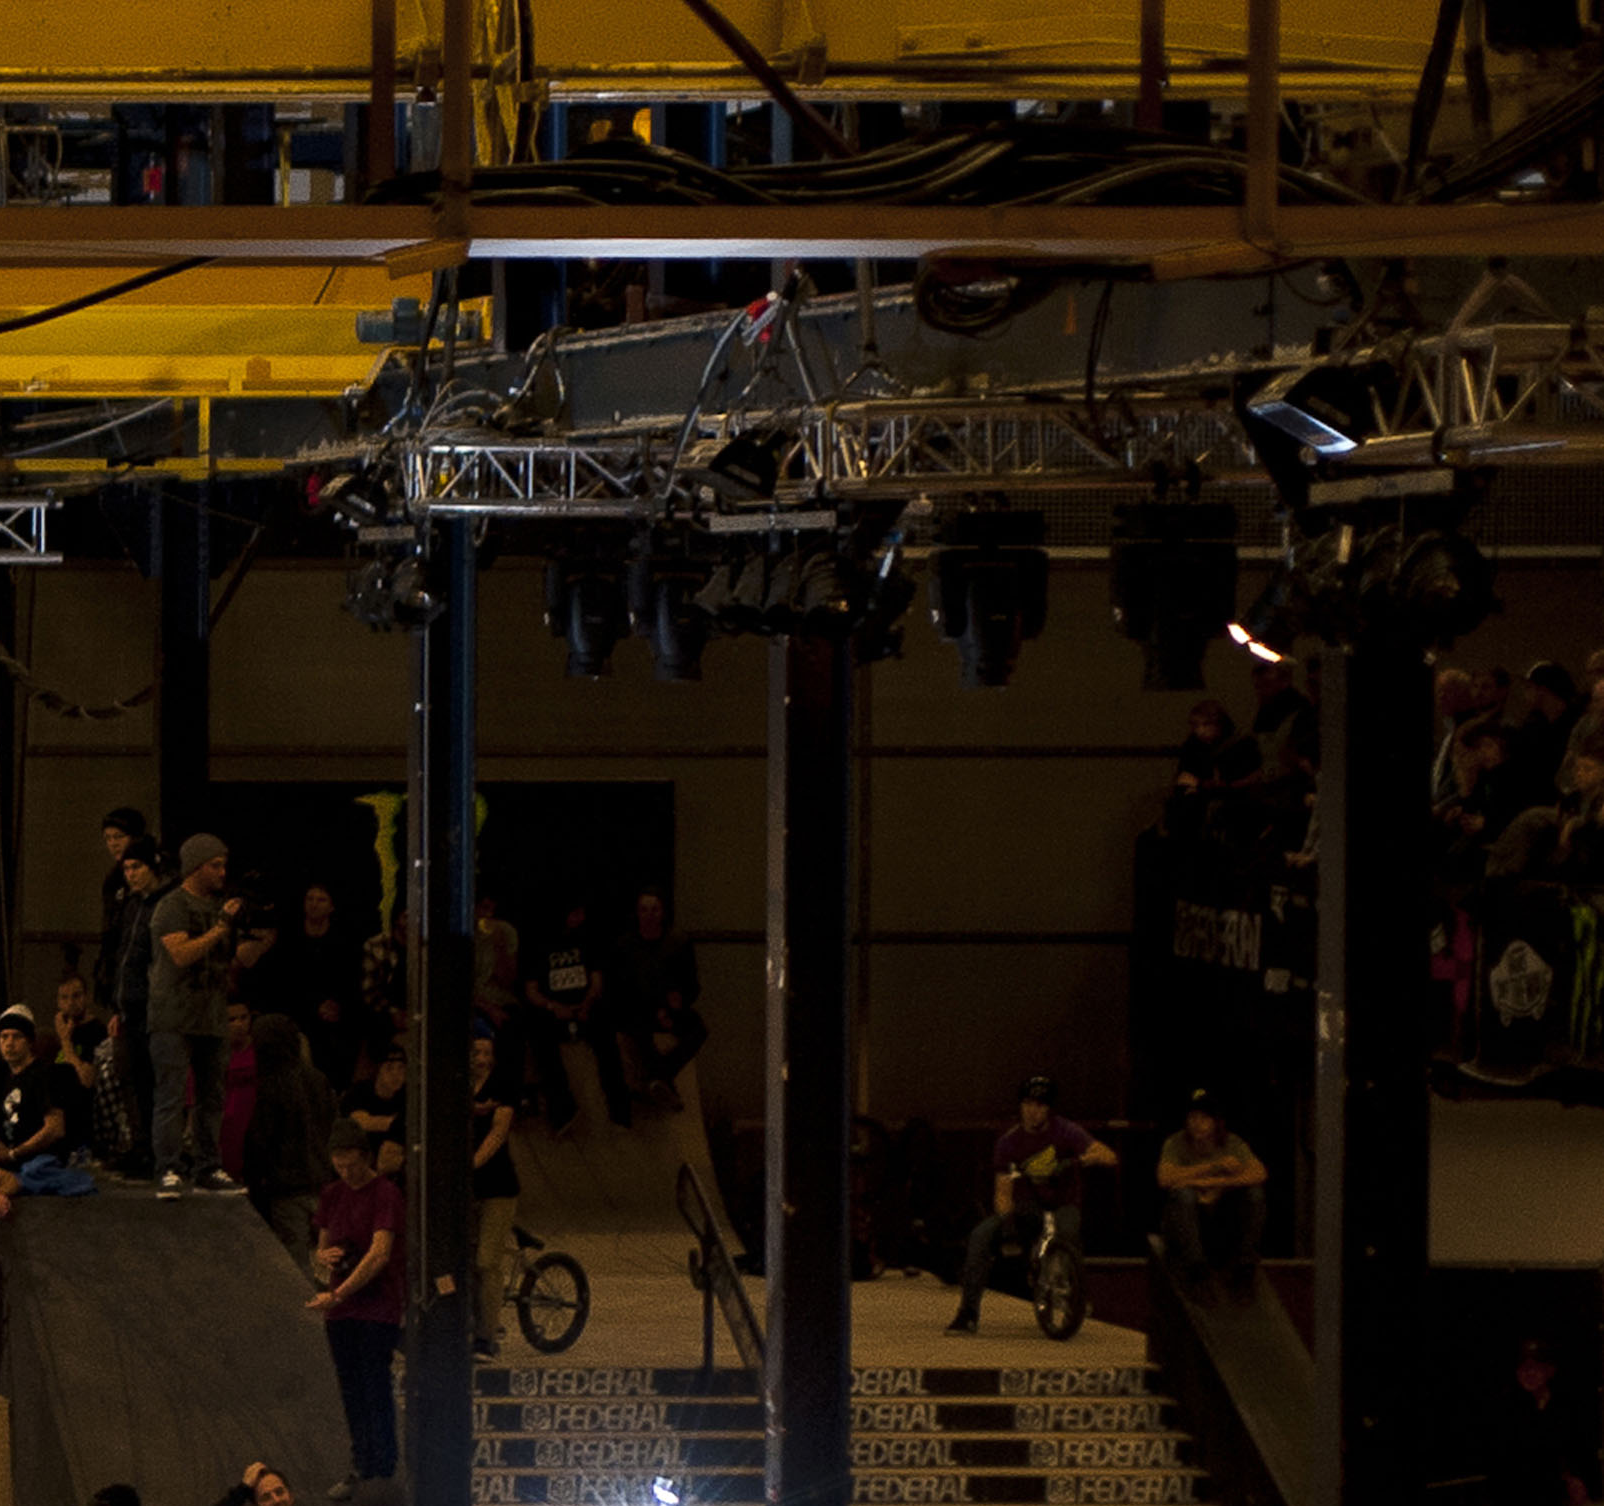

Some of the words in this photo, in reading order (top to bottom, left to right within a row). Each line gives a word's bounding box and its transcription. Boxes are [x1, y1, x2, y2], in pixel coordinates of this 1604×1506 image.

[540, 1369, 658, 1396] FEDERAL
[851, 1368, 930, 1395] DERAL
[1031, 1368, 1153, 1395] FEDERAL
[553, 1402, 673, 1430] FEDERAL
[1047, 1403, 1169, 1431] FEDERAL
[852, 1438, 958, 1466] EDERAL
[1061, 1438, 1185, 1466] FEDERAL
[852, 1474, 976, 1501] FEDERAL
[1078, 1474, 1202, 1501] FEDERAL
